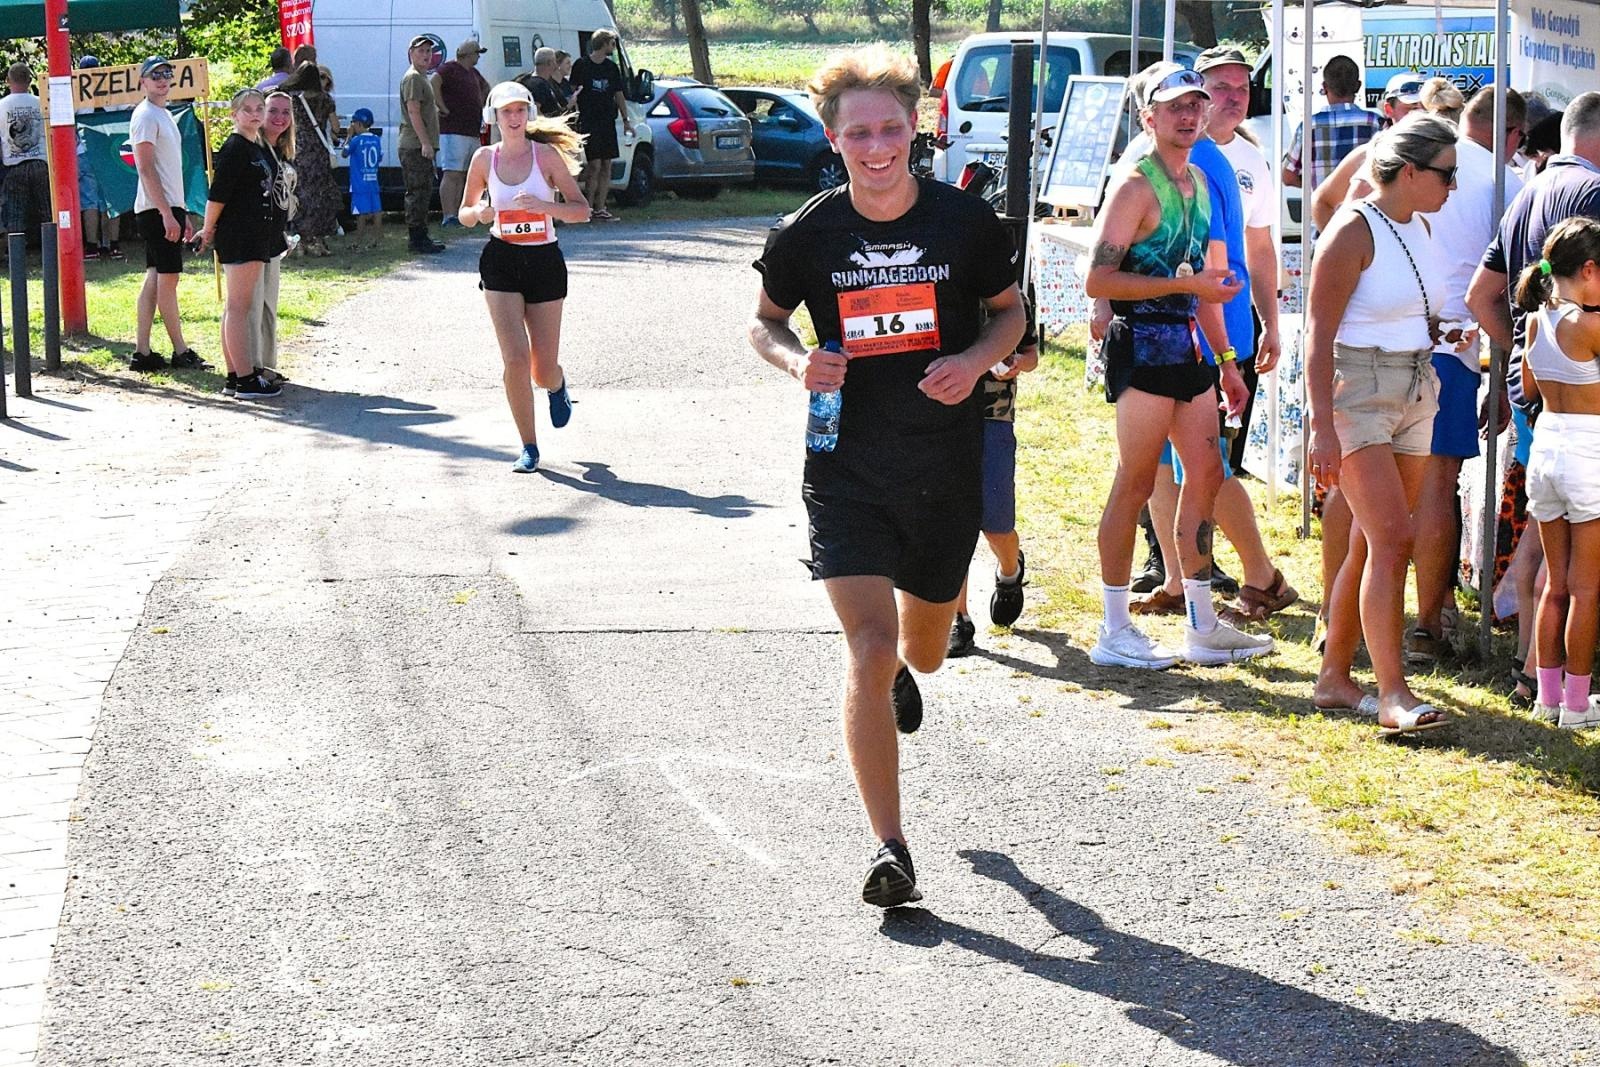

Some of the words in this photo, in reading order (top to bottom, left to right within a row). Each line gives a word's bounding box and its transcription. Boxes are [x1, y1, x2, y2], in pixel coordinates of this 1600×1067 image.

[361, 146, 378, 168] 10
[515, 223, 532, 234] 68
[831, 263, 950, 287] RUNMAGEDDON
[873, 313, 905, 336] 16
